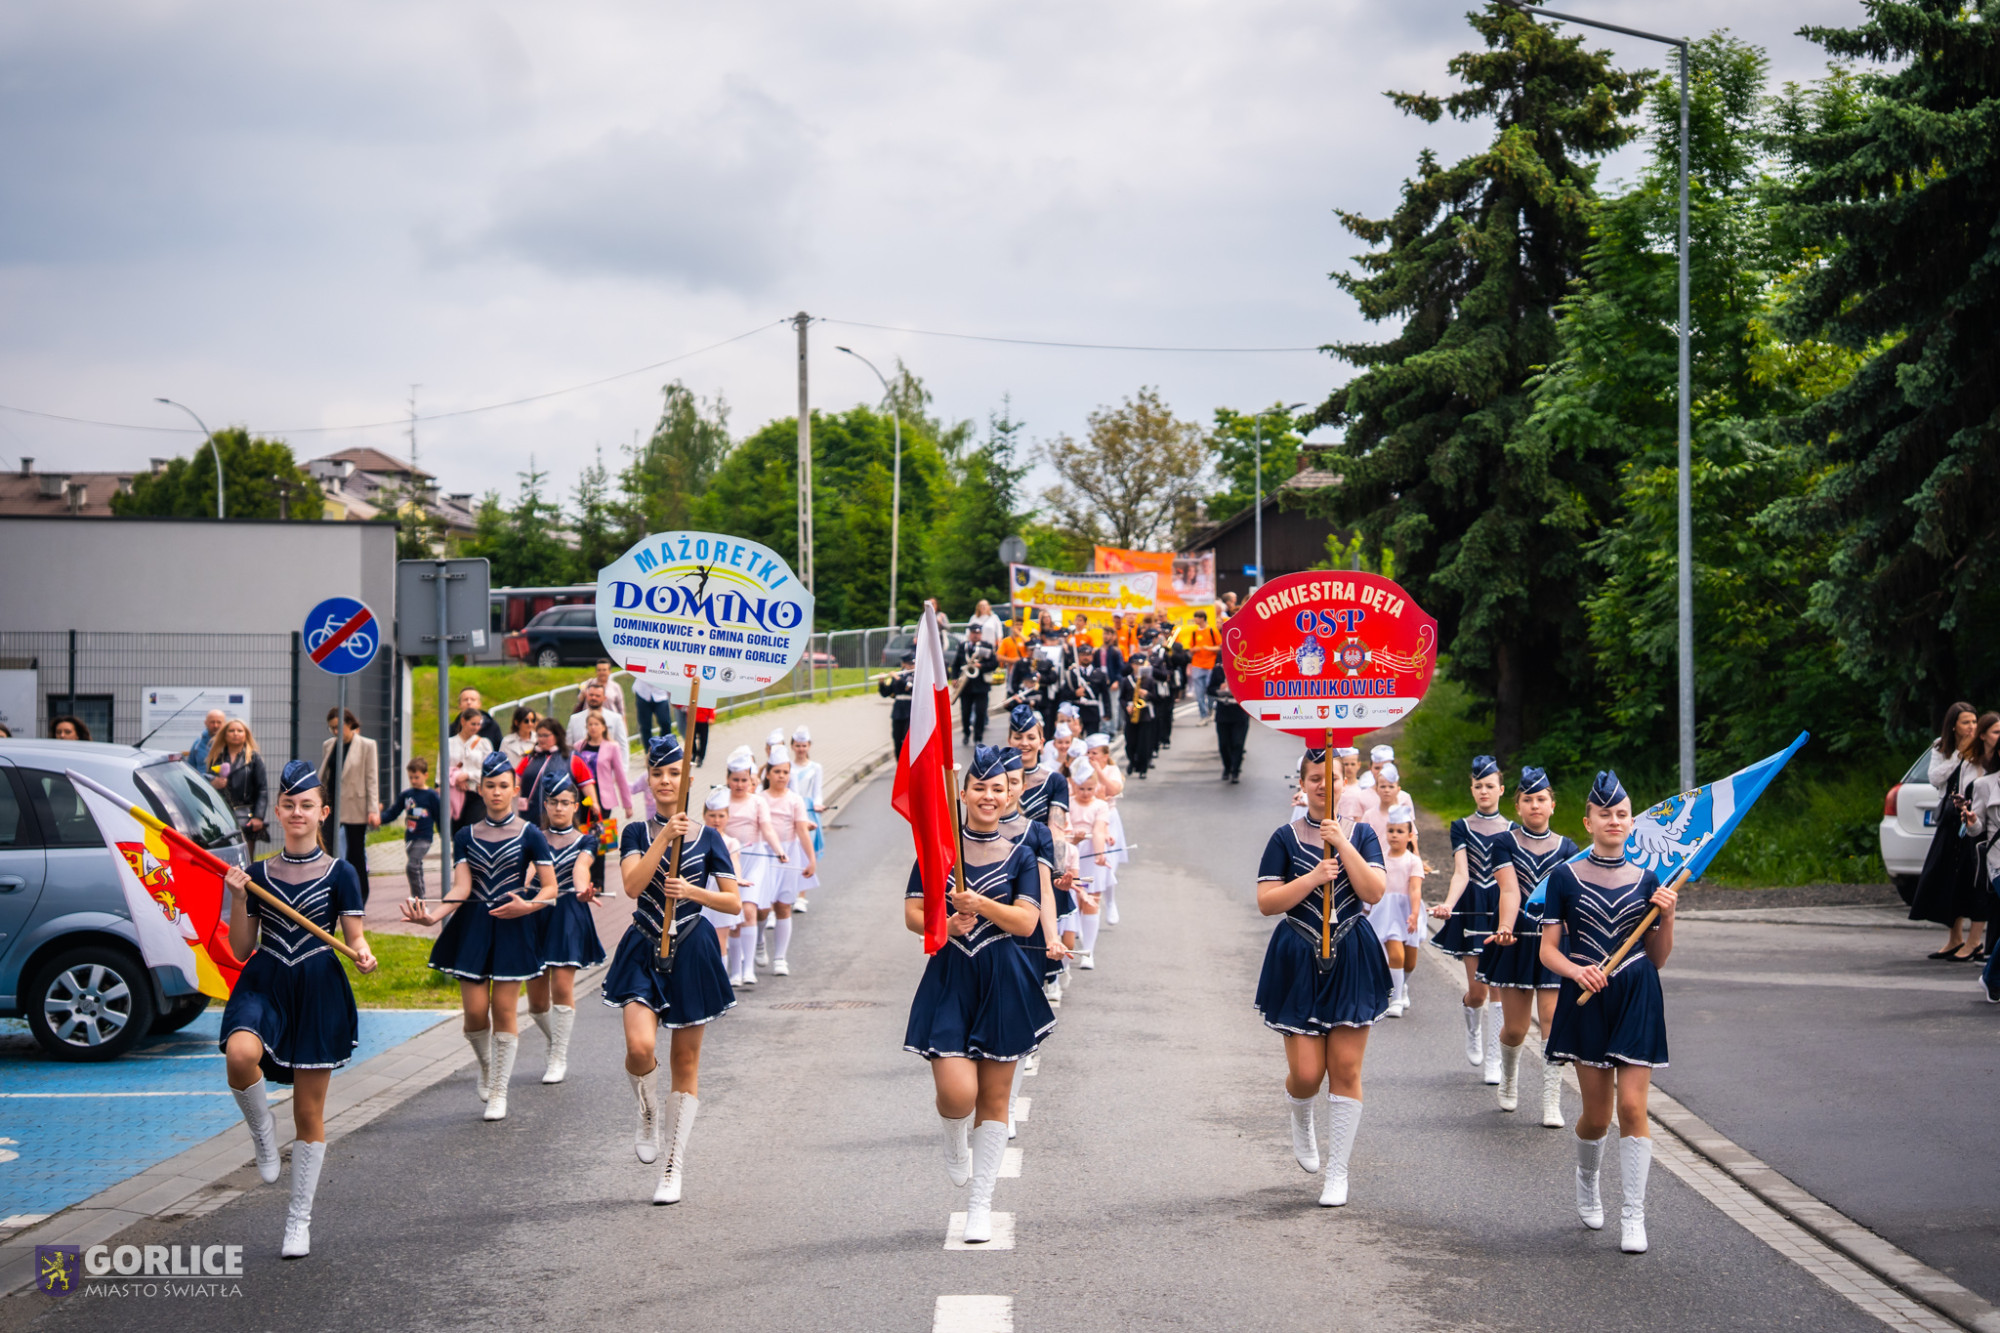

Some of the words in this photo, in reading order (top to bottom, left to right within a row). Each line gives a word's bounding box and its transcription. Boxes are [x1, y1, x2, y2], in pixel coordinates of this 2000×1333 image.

[633, 534, 789, 590] MAŻORETKI
[1033, 592, 1129, 609] ŻONKILOWY
[1054, 579, 1110, 594] MARSZ
[1255, 581, 1356, 620] ORKIESTRA
[1360, 584, 1405, 619] DĘTA
[607, 581, 803, 634] DOMINO
[1295, 608, 1365, 638] OSP
[612, 632, 660, 650] OŚRODEK
[662, 639, 707, 655] KULTURY
[708, 645, 743, 659] GMINY
[745, 649, 788, 665] GORLICE
[613, 617, 694, 638] DOMINIKOWICE
[709, 629, 744, 644] GMINA
[747, 633, 790, 649] GORLICE
[1263, 678, 1396, 698] DOMINIKOWICE
